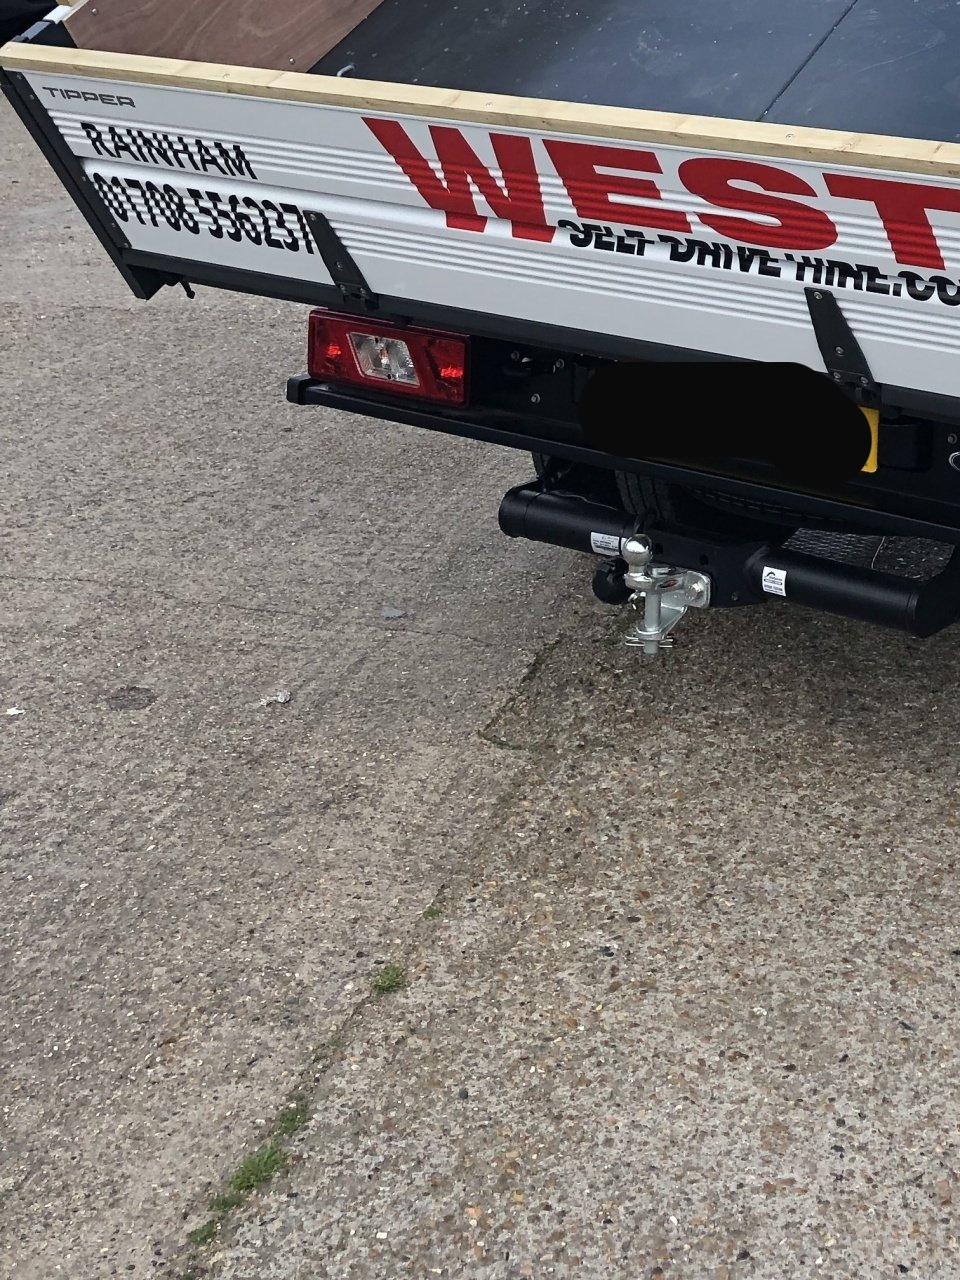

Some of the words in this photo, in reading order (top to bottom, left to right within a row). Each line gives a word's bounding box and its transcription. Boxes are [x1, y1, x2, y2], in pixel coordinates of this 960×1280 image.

[42, 86, 137, 109] TIPPER
[80, 122, 258, 180] RAINHAM
[93, 172, 200, 235] 01708
[557, 219, 655, 257] SELF
[658, 233, 782, 279] DRIVE
